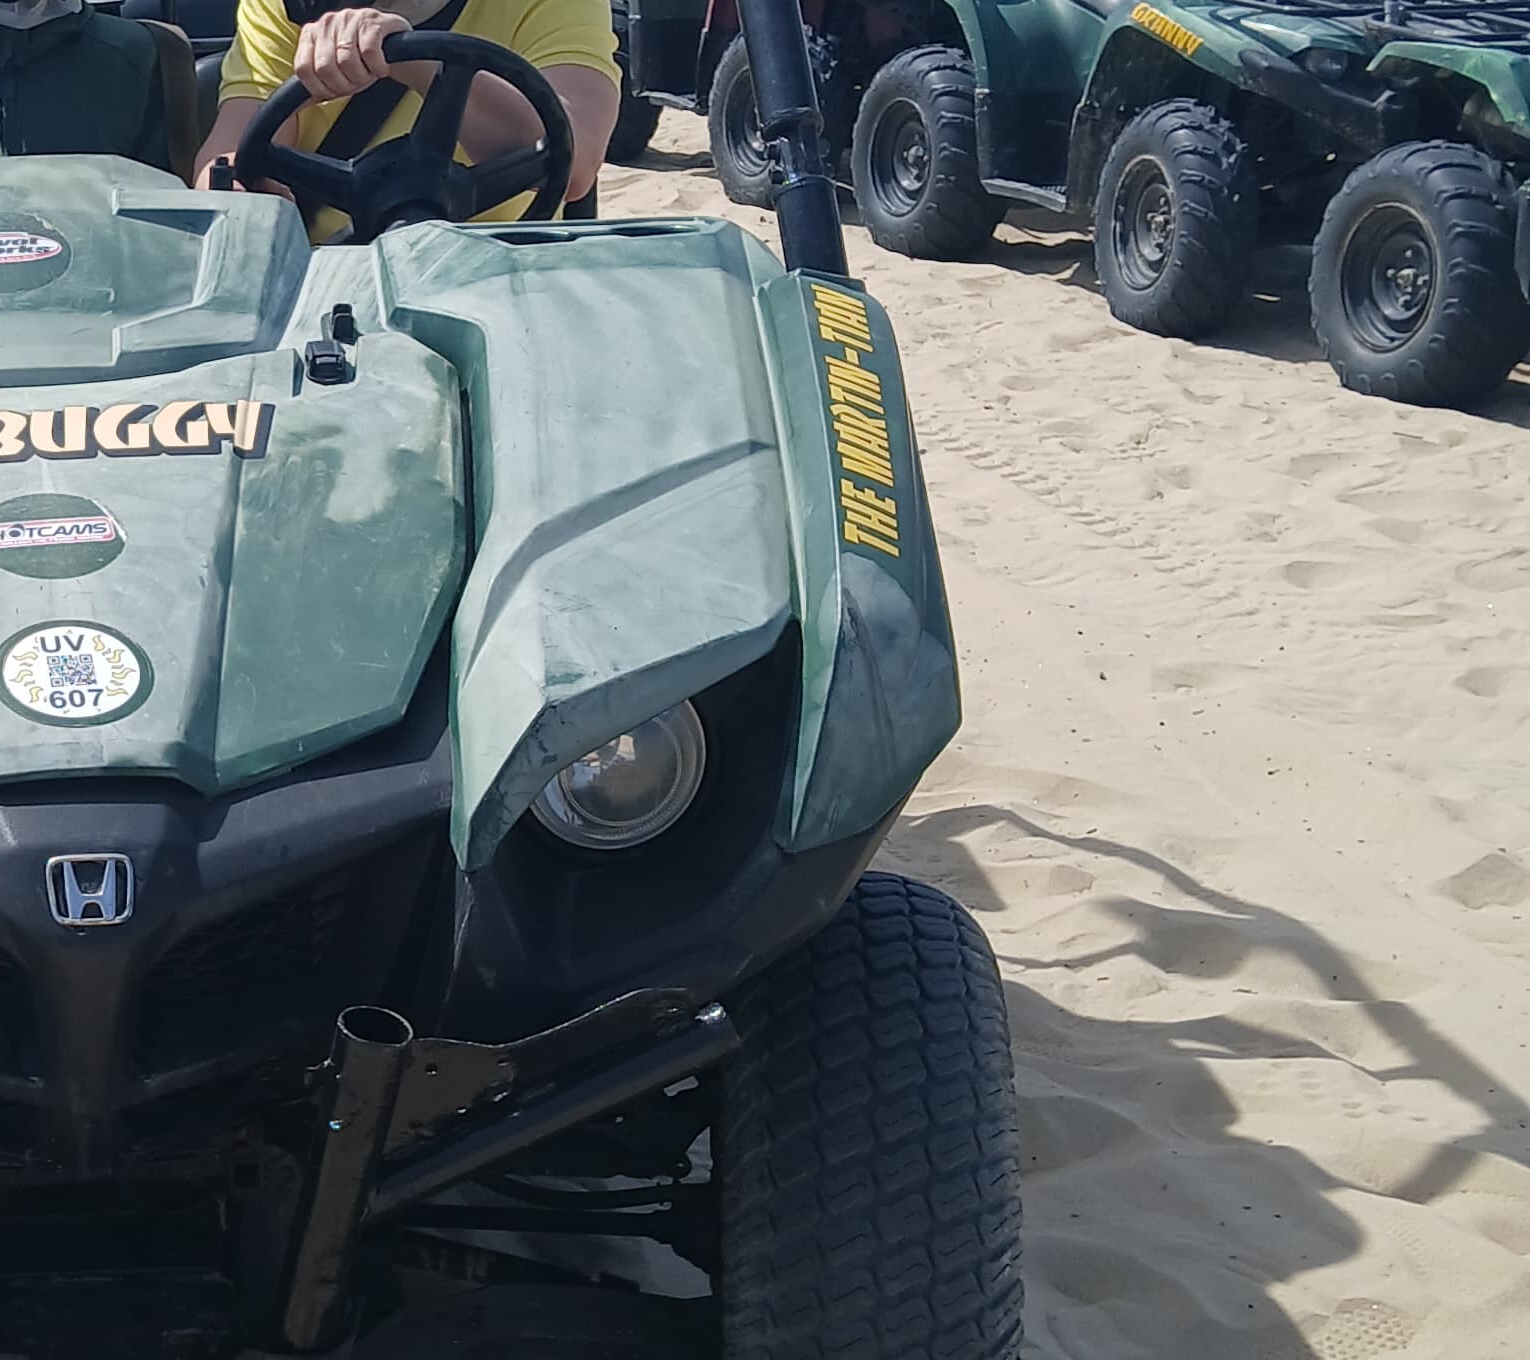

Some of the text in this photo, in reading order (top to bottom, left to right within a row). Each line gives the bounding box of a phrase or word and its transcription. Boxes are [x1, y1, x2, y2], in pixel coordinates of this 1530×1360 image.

[1130, 2, 1205, 56] GRANNY
[810, 283, 901, 557] THE MARTIN-TIAN
[39, 634, 85, 653] UV
[49, 688, 105, 709] 607
